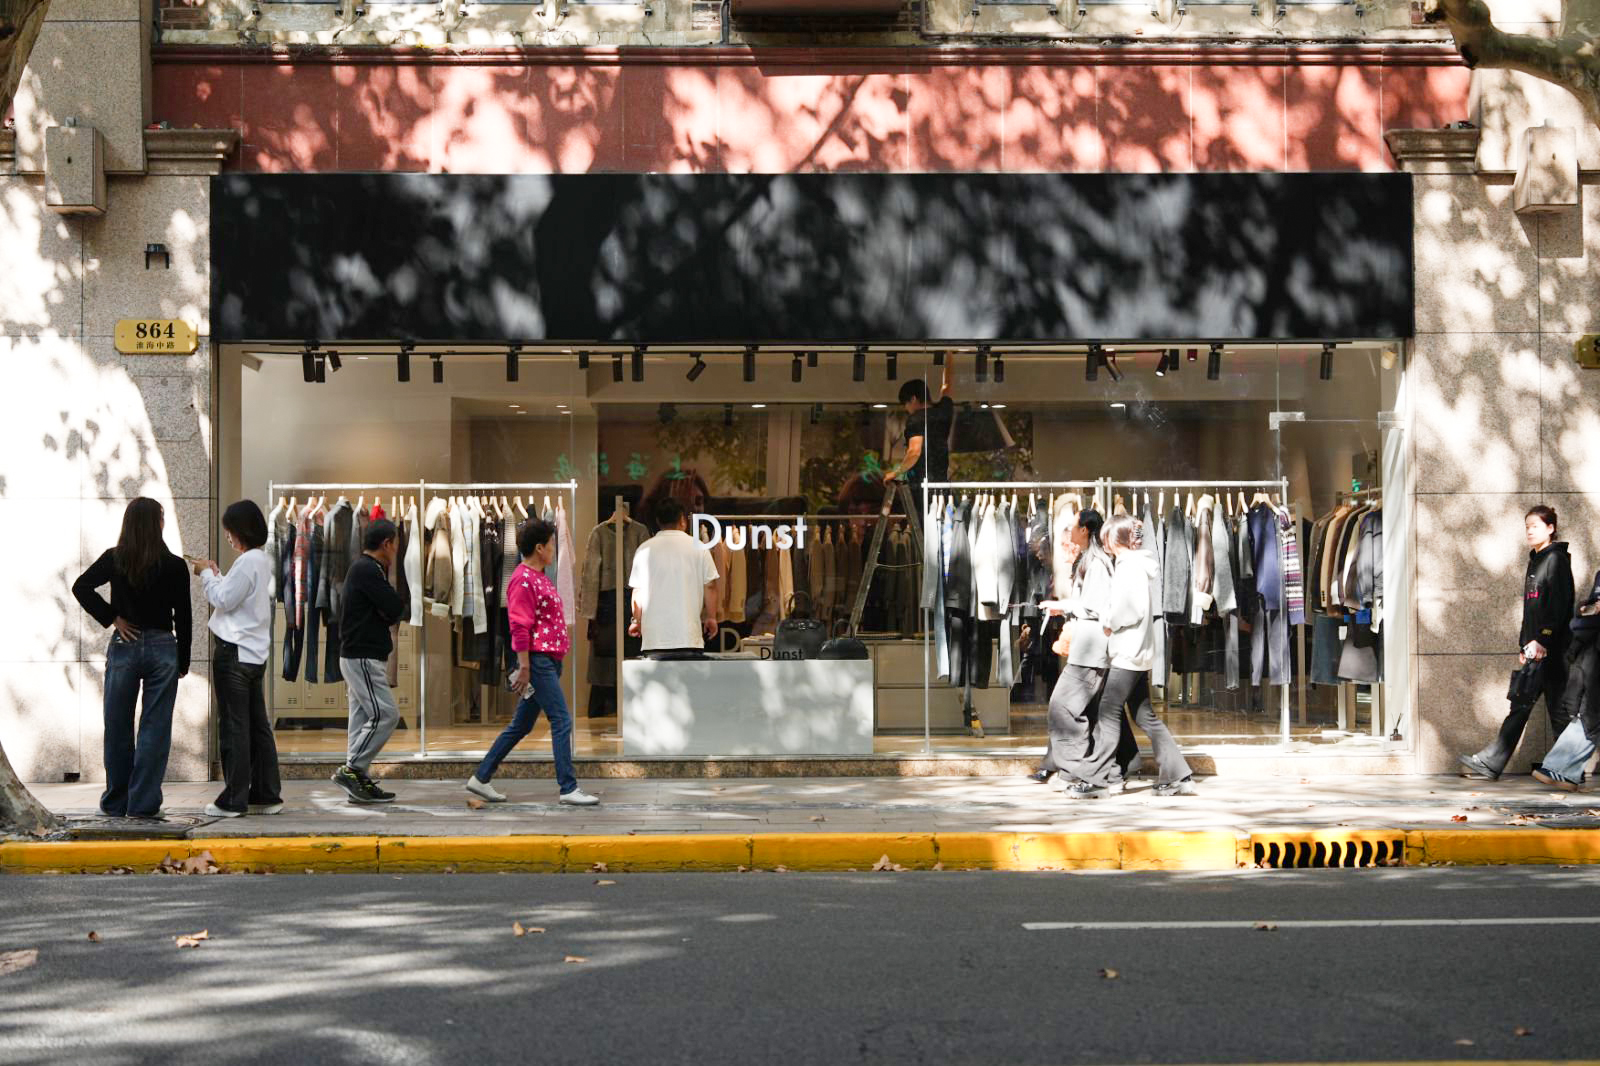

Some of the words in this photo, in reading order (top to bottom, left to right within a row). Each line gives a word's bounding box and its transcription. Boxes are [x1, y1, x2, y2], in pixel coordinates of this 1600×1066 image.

[136, 322, 175, 339] 864
[692, 513, 808, 551] Dunst
[760, 646, 803, 661] Dunst
